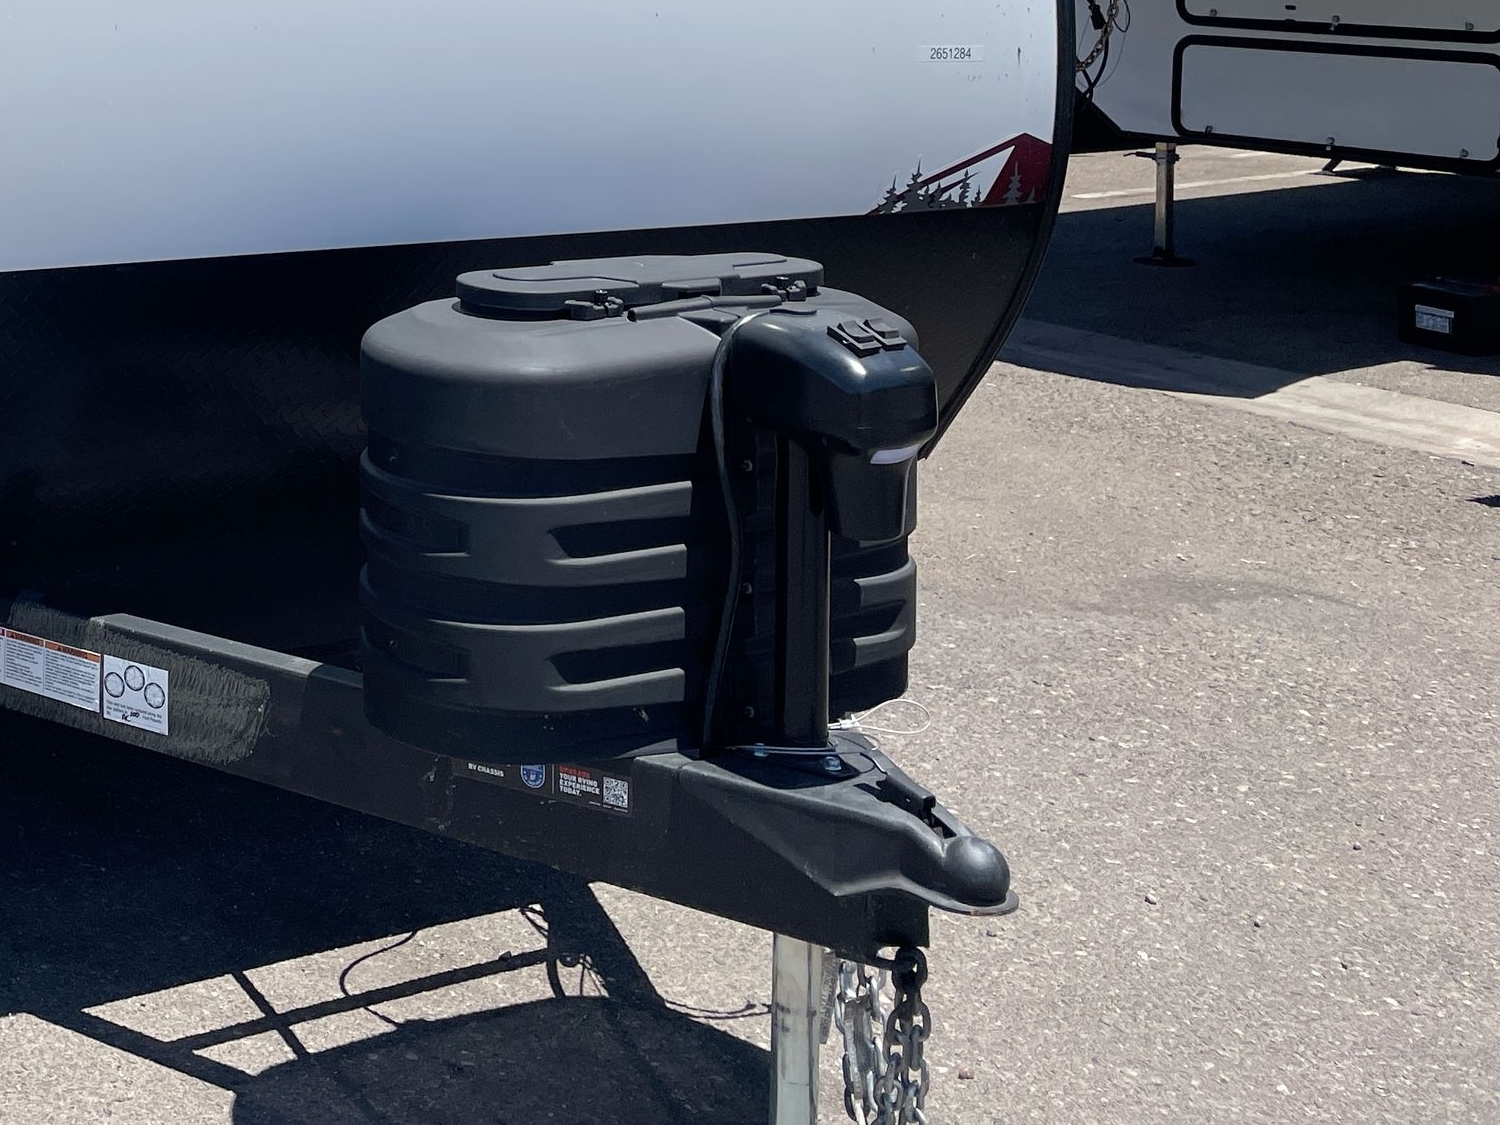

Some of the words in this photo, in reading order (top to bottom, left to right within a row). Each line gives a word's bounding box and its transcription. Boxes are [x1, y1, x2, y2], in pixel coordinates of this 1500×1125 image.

[930, 46, 972, 60] 2651284
[468, 762, 477, 771] RV
[477, 765, 505, 777] CHASSIS
[559, 772, 577, 783] YOUR
[559, 778, 600, 795] EXPERIENCE
[559, 785, 582, 797] TODAY.
